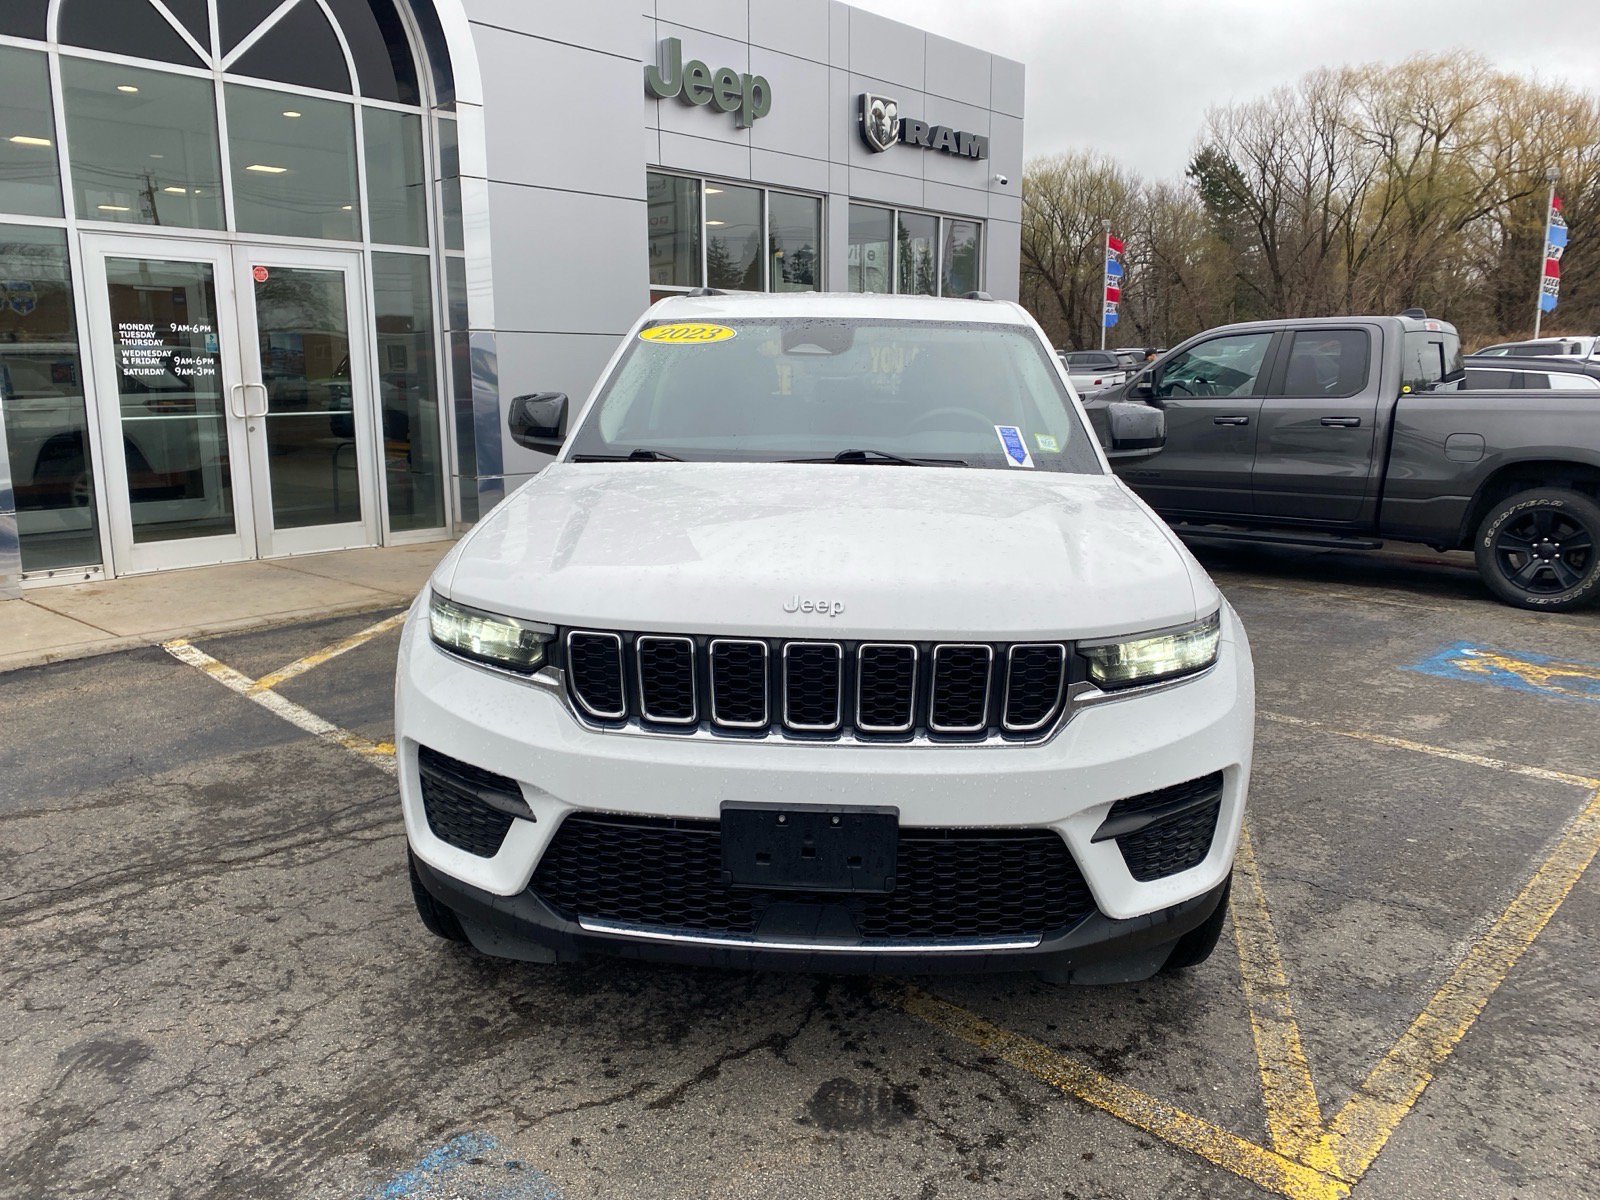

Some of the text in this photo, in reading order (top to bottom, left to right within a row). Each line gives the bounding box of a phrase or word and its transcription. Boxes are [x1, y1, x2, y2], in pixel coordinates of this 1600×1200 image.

[645, 37, 771, 128] Jeep
[904, 117, 988, 159] RAM
[118, 323, 154, 331] MONDAY
[651, 327, 723, 340] 2023
[120, 338, 164, 346] THURSDAY
[122, 357, 129, 365] &
[131, 357, 160, 365] FRIDAY
[123, 368, 165, 376] SATURDAY
[1484, 499, 1564, 547] GOODYEAR
[783, 594, 845, 617] Jeep
